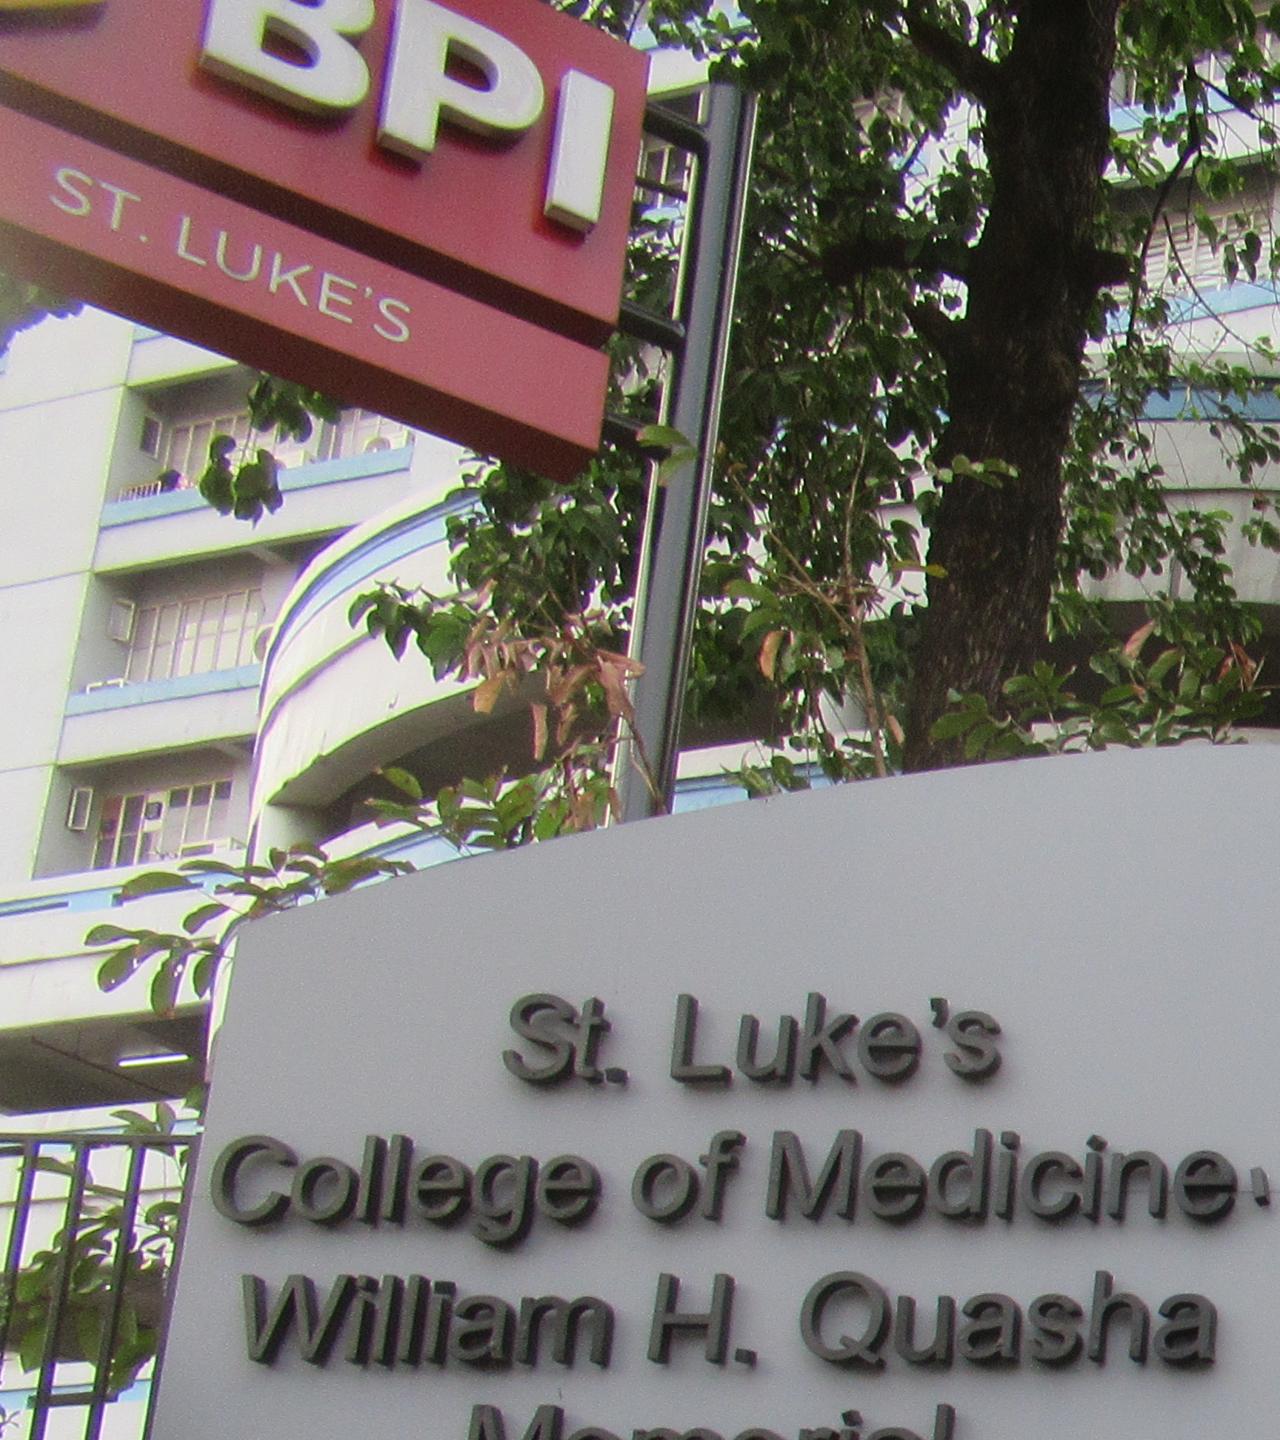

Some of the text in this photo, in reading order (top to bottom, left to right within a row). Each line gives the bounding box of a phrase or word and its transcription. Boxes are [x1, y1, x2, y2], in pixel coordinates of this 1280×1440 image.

[200, 0, 614, 234] BPI
[48, 166, 412, 345] ST. LUKE'S
[502, 992, 1002, 1086] St. Luke's
[210, 1134, 602, 1248] College
[631, 1129, 748, 1225] of
[240, 1270, 1219, 1370] William H. Quasha
